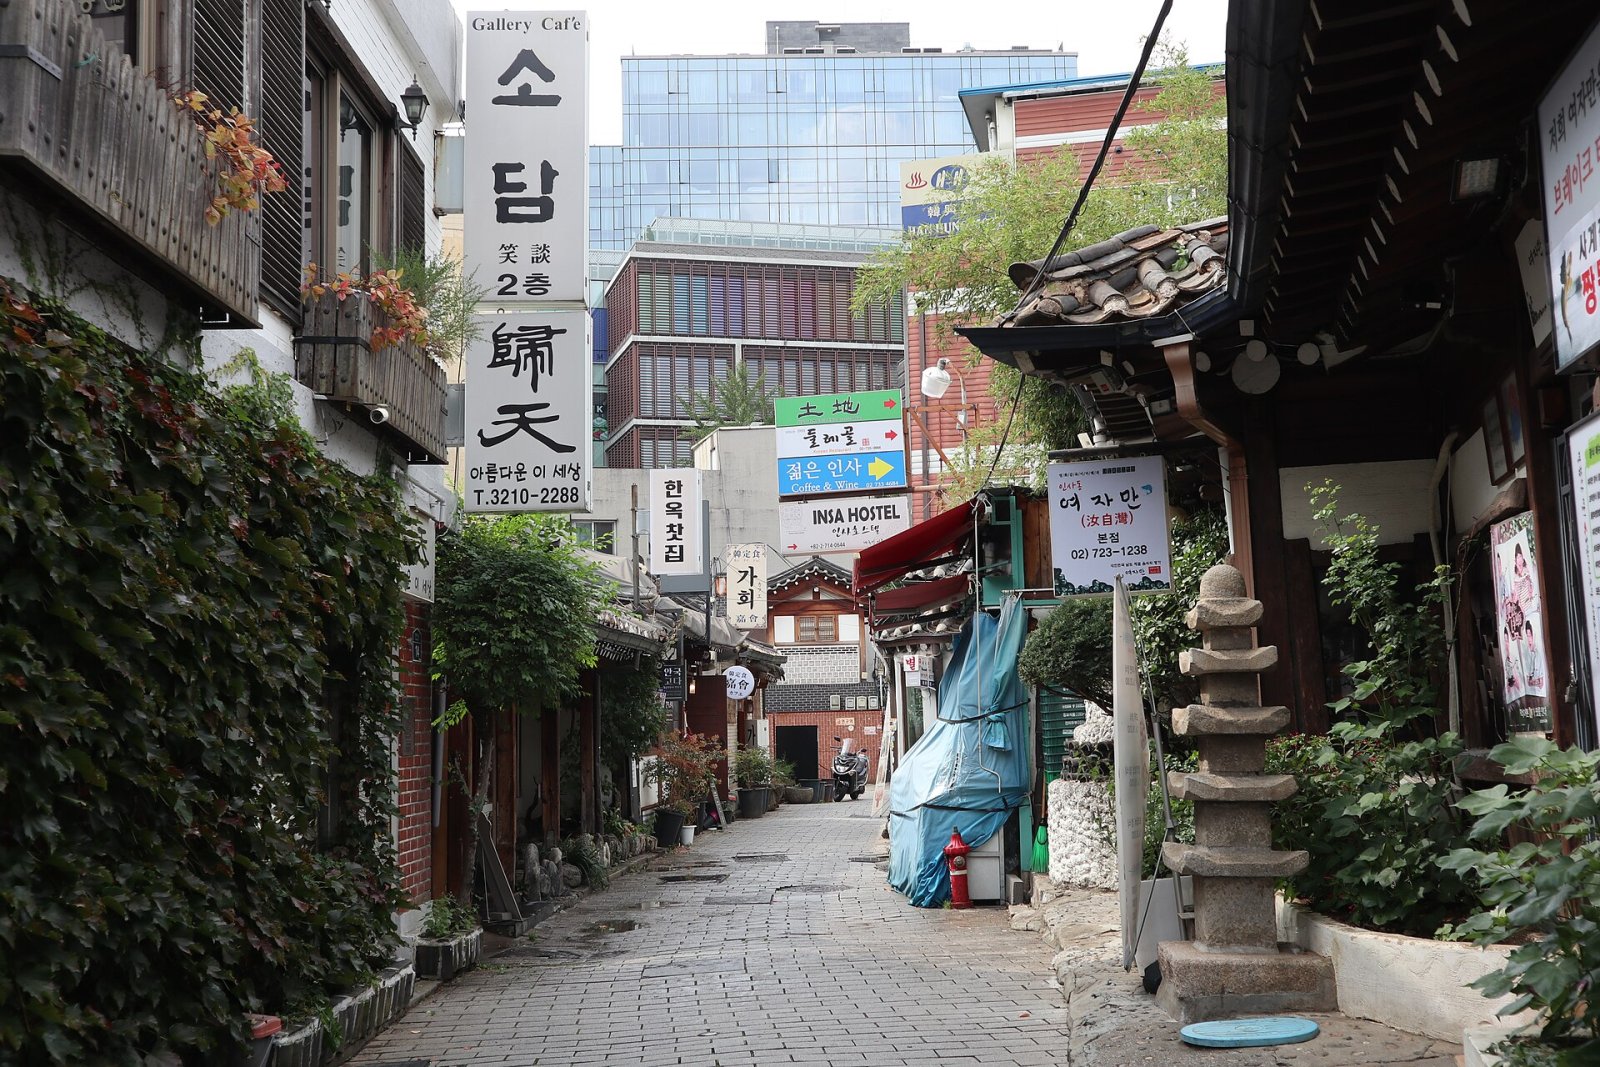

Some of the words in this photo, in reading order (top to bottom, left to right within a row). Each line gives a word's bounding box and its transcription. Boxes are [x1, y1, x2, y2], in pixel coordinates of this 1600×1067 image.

[472, 17, 532, 34] Gallery
[1568, 66, 1600, 129] 여자만
[491, 48, 562, 224] 소담
[1554, 146, 1593, 216] 브레이크
[1579, 217, 1600, 260] 사계
[497, 273, 552, 296] 2층
[1581, 259, 1600, 315] 짱
[797, 396, 860, 418] 土地
[470, 462, 528, 483] 아름다운
[533, 464, 546, 479] 이
[552, 462, 581, 481] 세상
[786, 460, 822, 481] 젊은
[827, 457, 862, 478] 인사
[473, 487, 579, 506] T.3210-2288
[791, 481, 821, 493] Coffee
[823, 481, 833, 491] &
[835, 480, 859, 490] Wine
[1059, 486, 1141, 512] 여자만
[664, 480, 684, 563] 한옥찻집
[812, 509, 845, 525] INSA
[848, 504, 901, 522] HOSTEL
[1097, 532, 1120, 544] 본점
[1071, 547, 1089, 560] 02)
[1092, 544, 1148, 558] 723-1238
[736, 565, 758, 610] 가회
